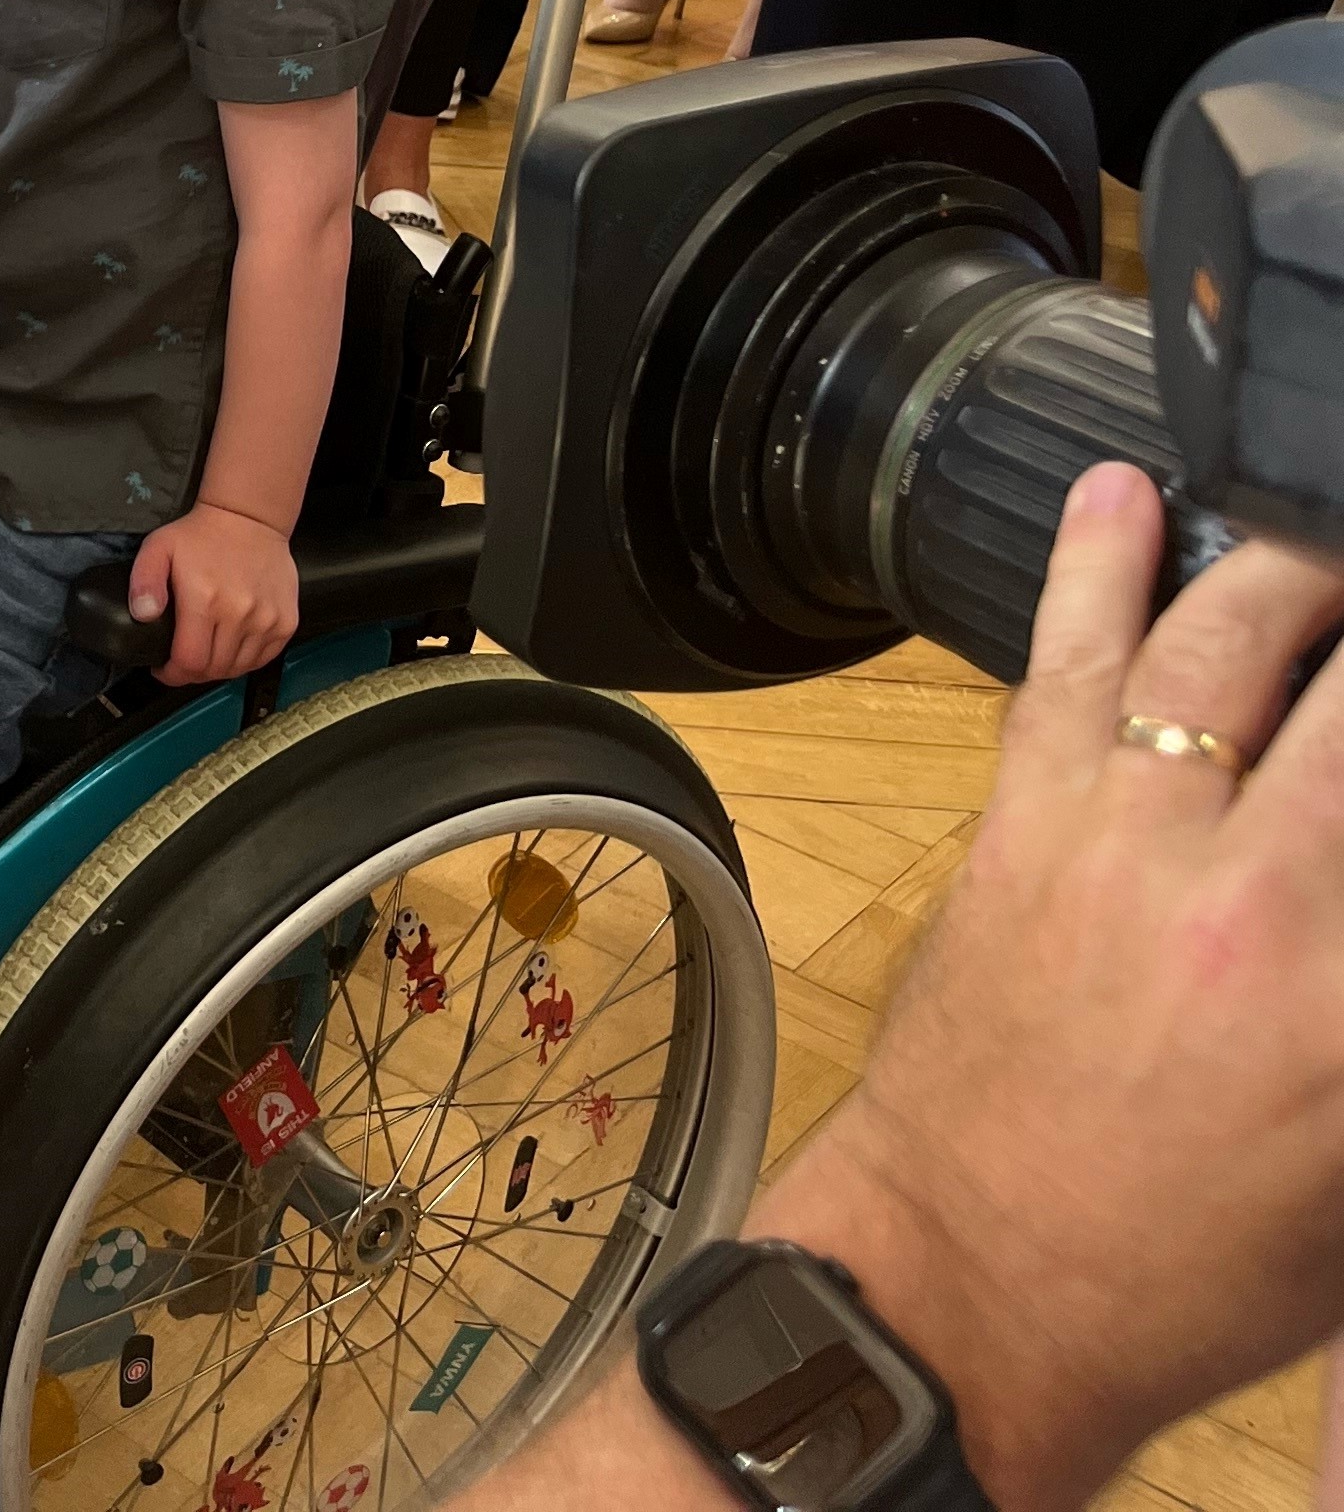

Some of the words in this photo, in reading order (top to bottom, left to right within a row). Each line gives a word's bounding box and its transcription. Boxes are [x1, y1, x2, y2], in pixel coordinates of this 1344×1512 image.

[897, 449, 921, 496] CANON
[917, 408, 941, 442] HDTV
[939, 366, 969, 402] ZOOM
[225, 1047, 280, 1104] ANFIELD
[259, 1138, 277, 1156] IS
[278, 1109, 311, 1140] THIS
[428, 1341, 476, 1398] YNWA
